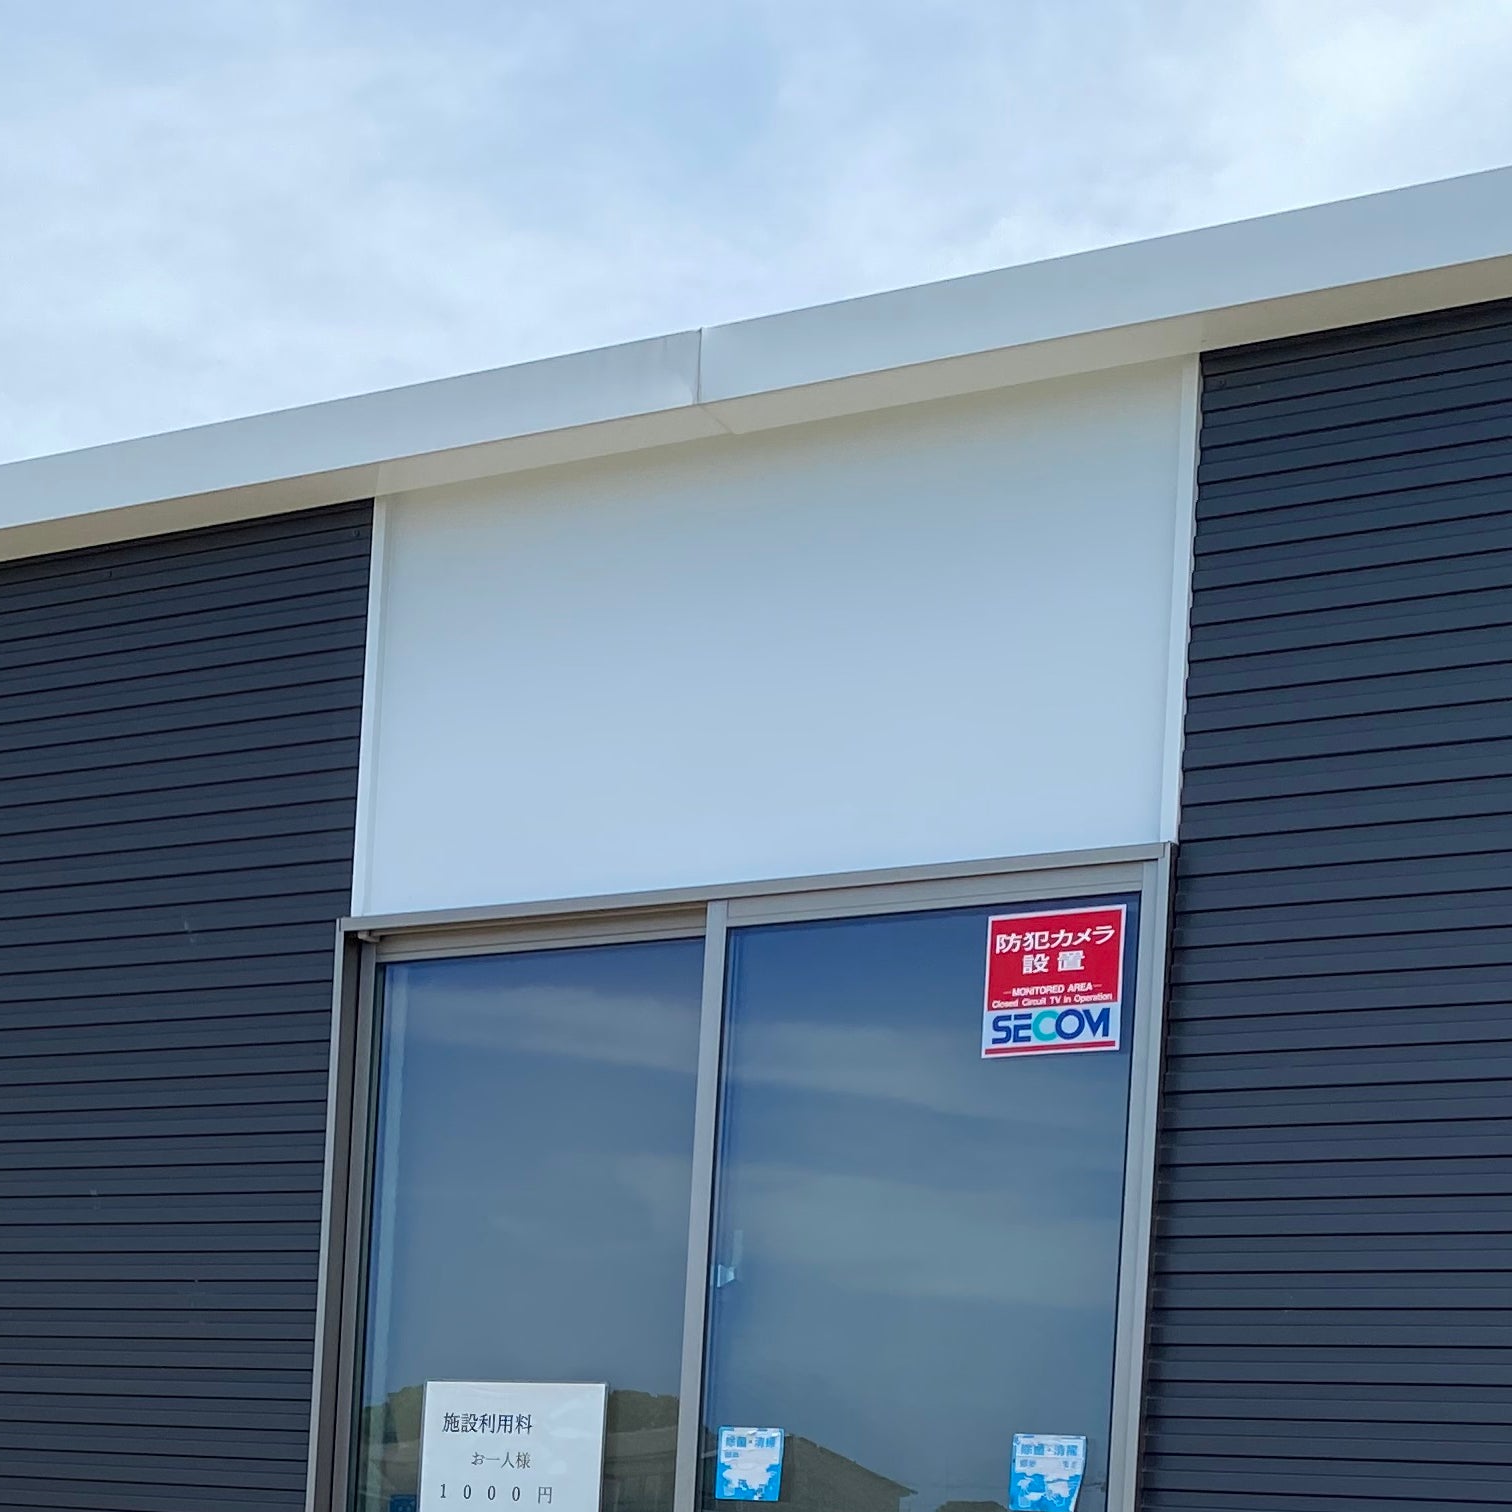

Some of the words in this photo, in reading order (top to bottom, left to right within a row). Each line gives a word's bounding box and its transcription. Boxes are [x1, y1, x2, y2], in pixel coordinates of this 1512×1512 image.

[995, 925, 1115, 954] 防犯カメラ
[1022, 950, 1085, 975] 設置
[991, 999, 1019, 1009] Closed
[1021, 997, 1047, 1007] Circuit
[1049, 995, 1062, 1005] TV
[1074, 992, 1113, 1004] Operation
[1011, 984, 1065, 998] MONITORED
[1067, 982, 1093, 993] AREA
[991, 1008, 1111, 1045] SECOM
[441, 1411, 534, 1435] 施設利用料
[471, 1451, 532, 1470] お一人様
